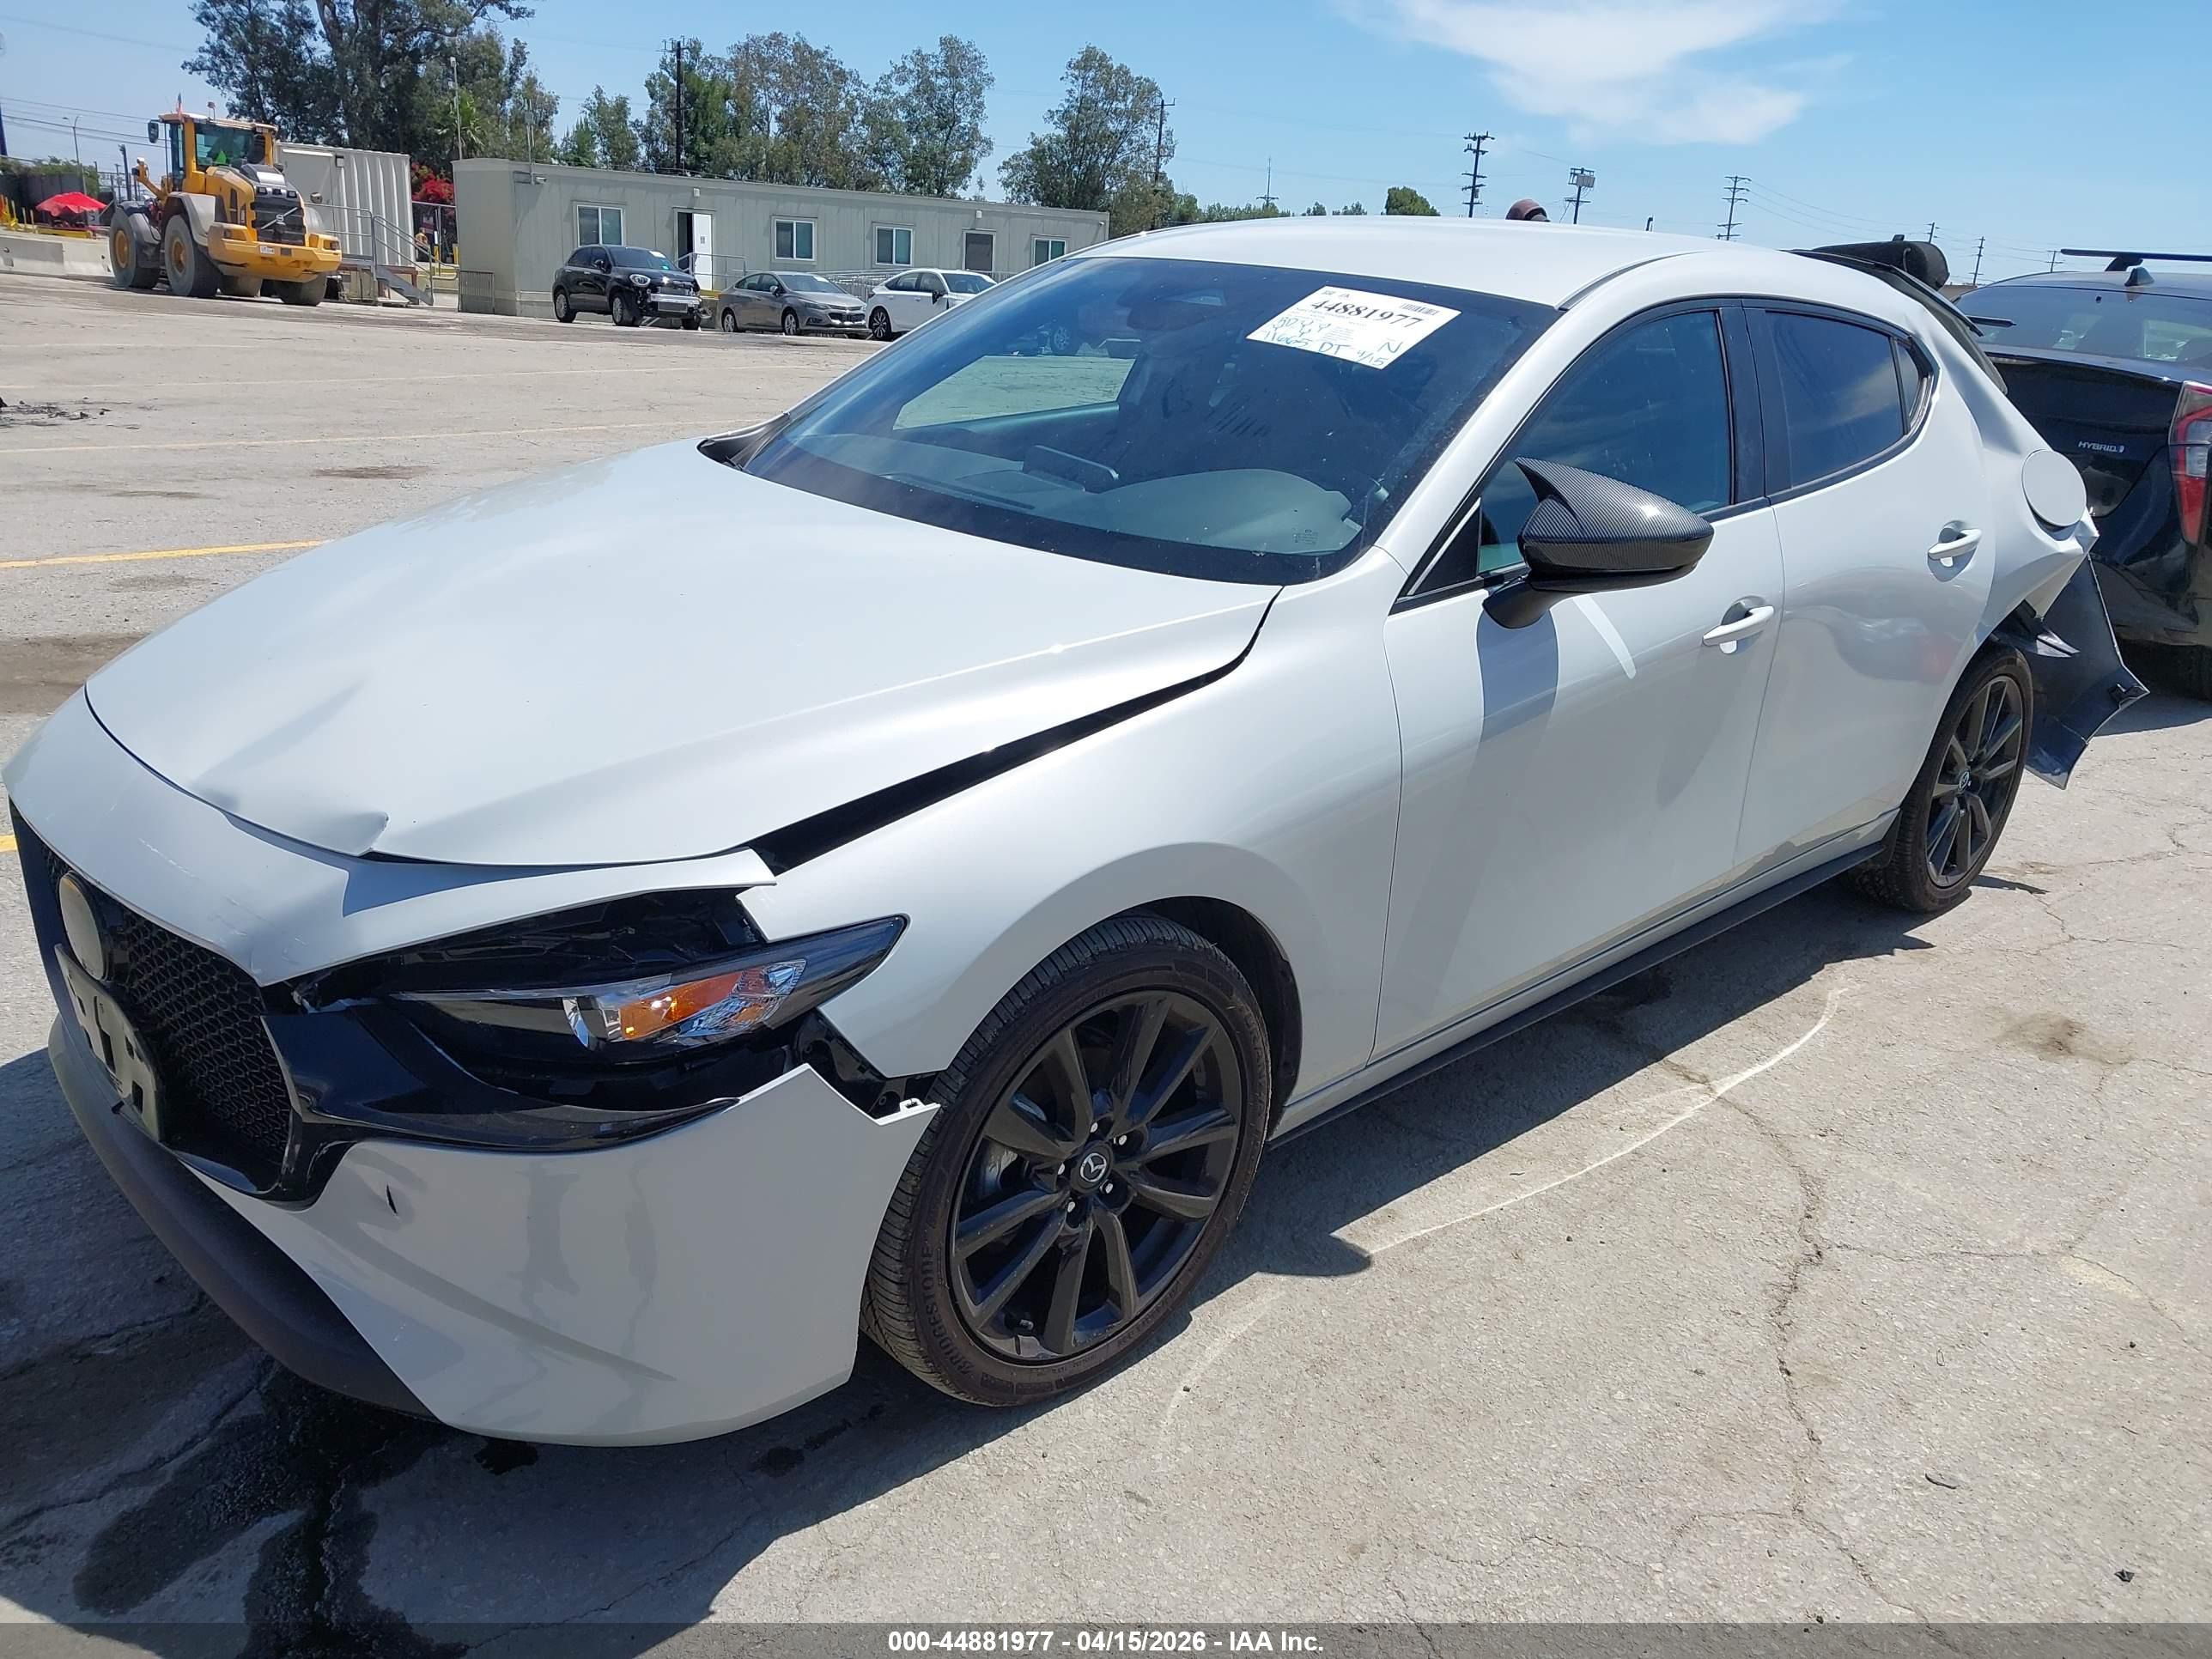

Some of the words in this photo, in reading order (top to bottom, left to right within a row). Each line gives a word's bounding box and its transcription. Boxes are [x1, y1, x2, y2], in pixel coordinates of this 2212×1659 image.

[1311, 301, 1425, 327] 44881977
[1376, 342, 1404, 354] N
[2078, 441, 2118, 452] HYBRID
[920, 1243, 975, 1374] BRIDGESTONE
